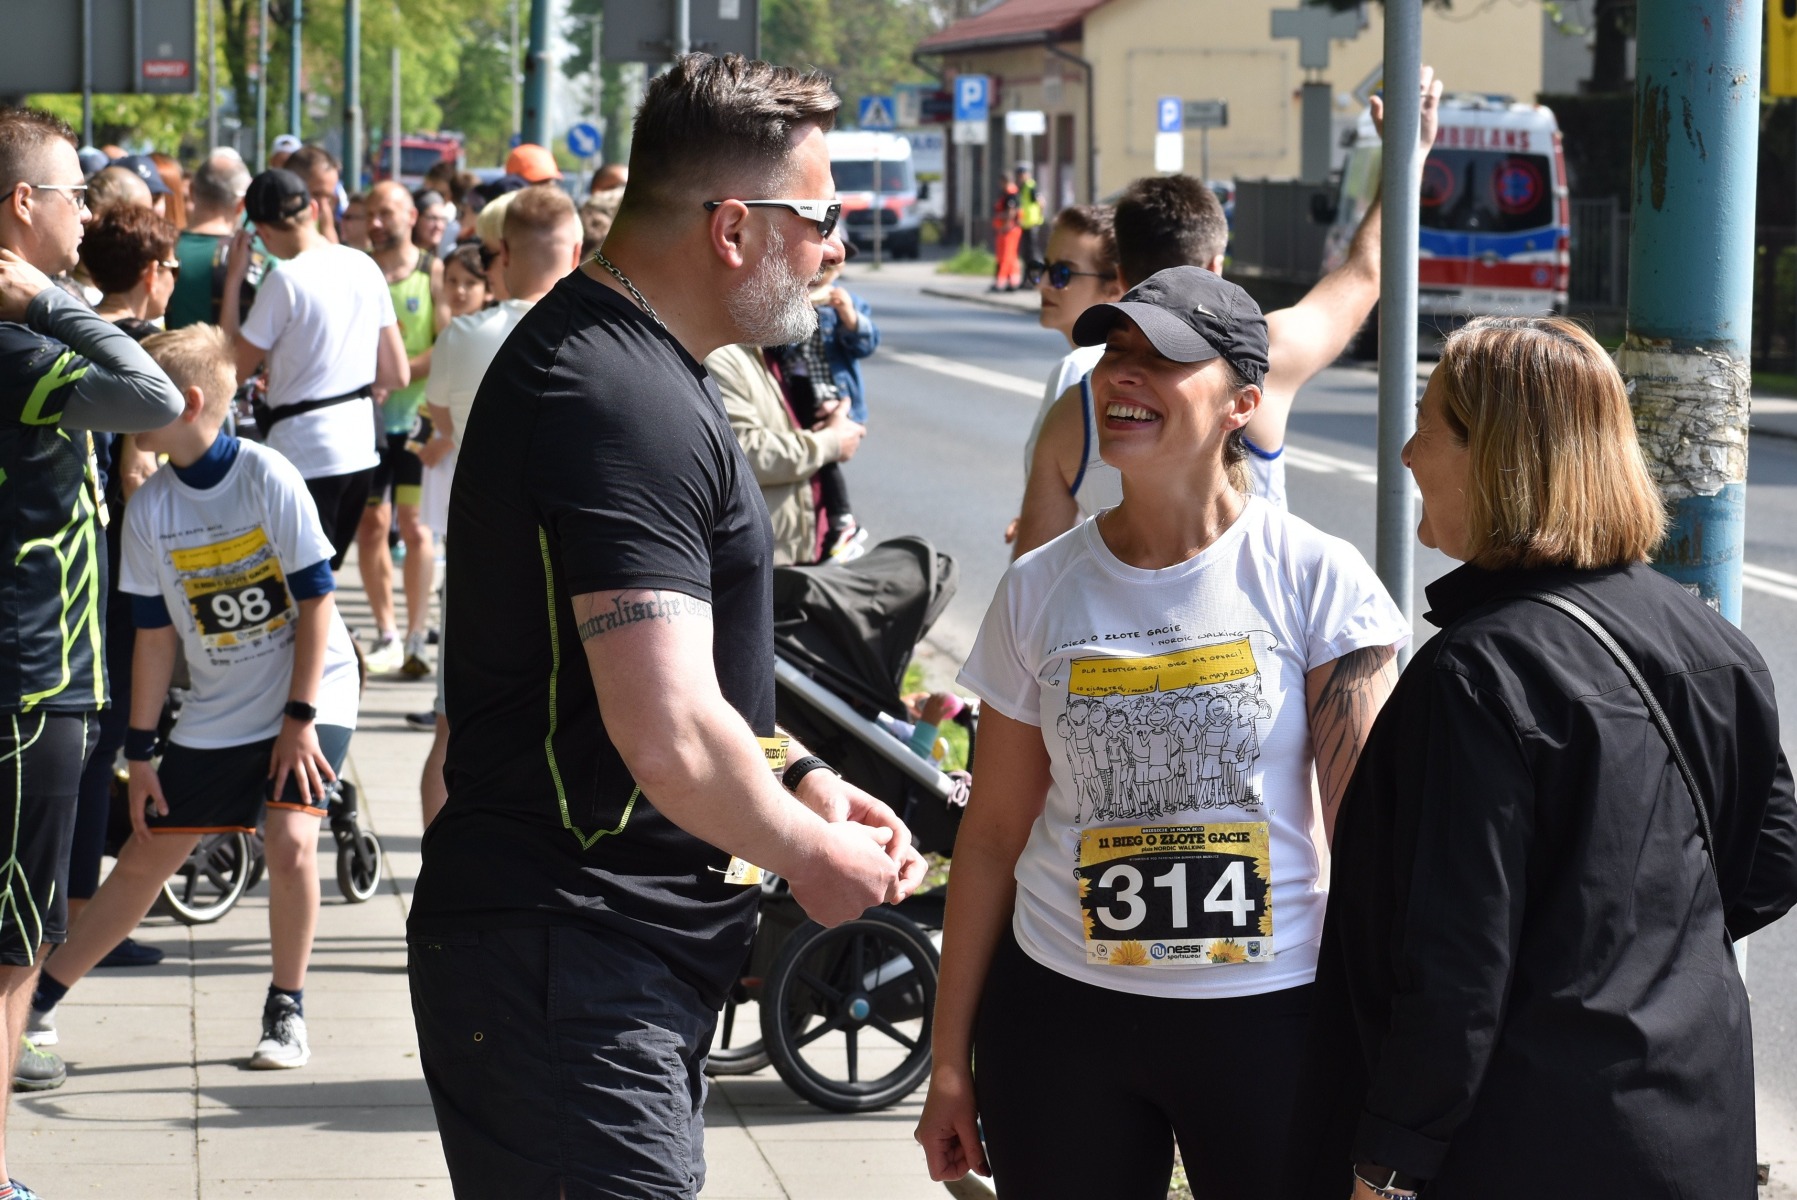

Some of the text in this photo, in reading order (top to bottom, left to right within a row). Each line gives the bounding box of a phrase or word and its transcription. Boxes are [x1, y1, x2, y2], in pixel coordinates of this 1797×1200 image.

[961, 80, 983, 109] P
[1161, 100, 1179, 129] P
[1434, 126, 1530, 150] MBULANS
[211, 587, 271, 628] 98
[1105, 632, 1140, 640] ZŁOTE
[1209, 672, 1228, 681] MAJA
[1230, 667, 1250, 675] 2023
[765, 748, 780, 759] BIEG
[1099, 832, 1250, 848] 11 BIEG O ZŁOTE GACIE
[1096, 861, 1255, 931] 314
